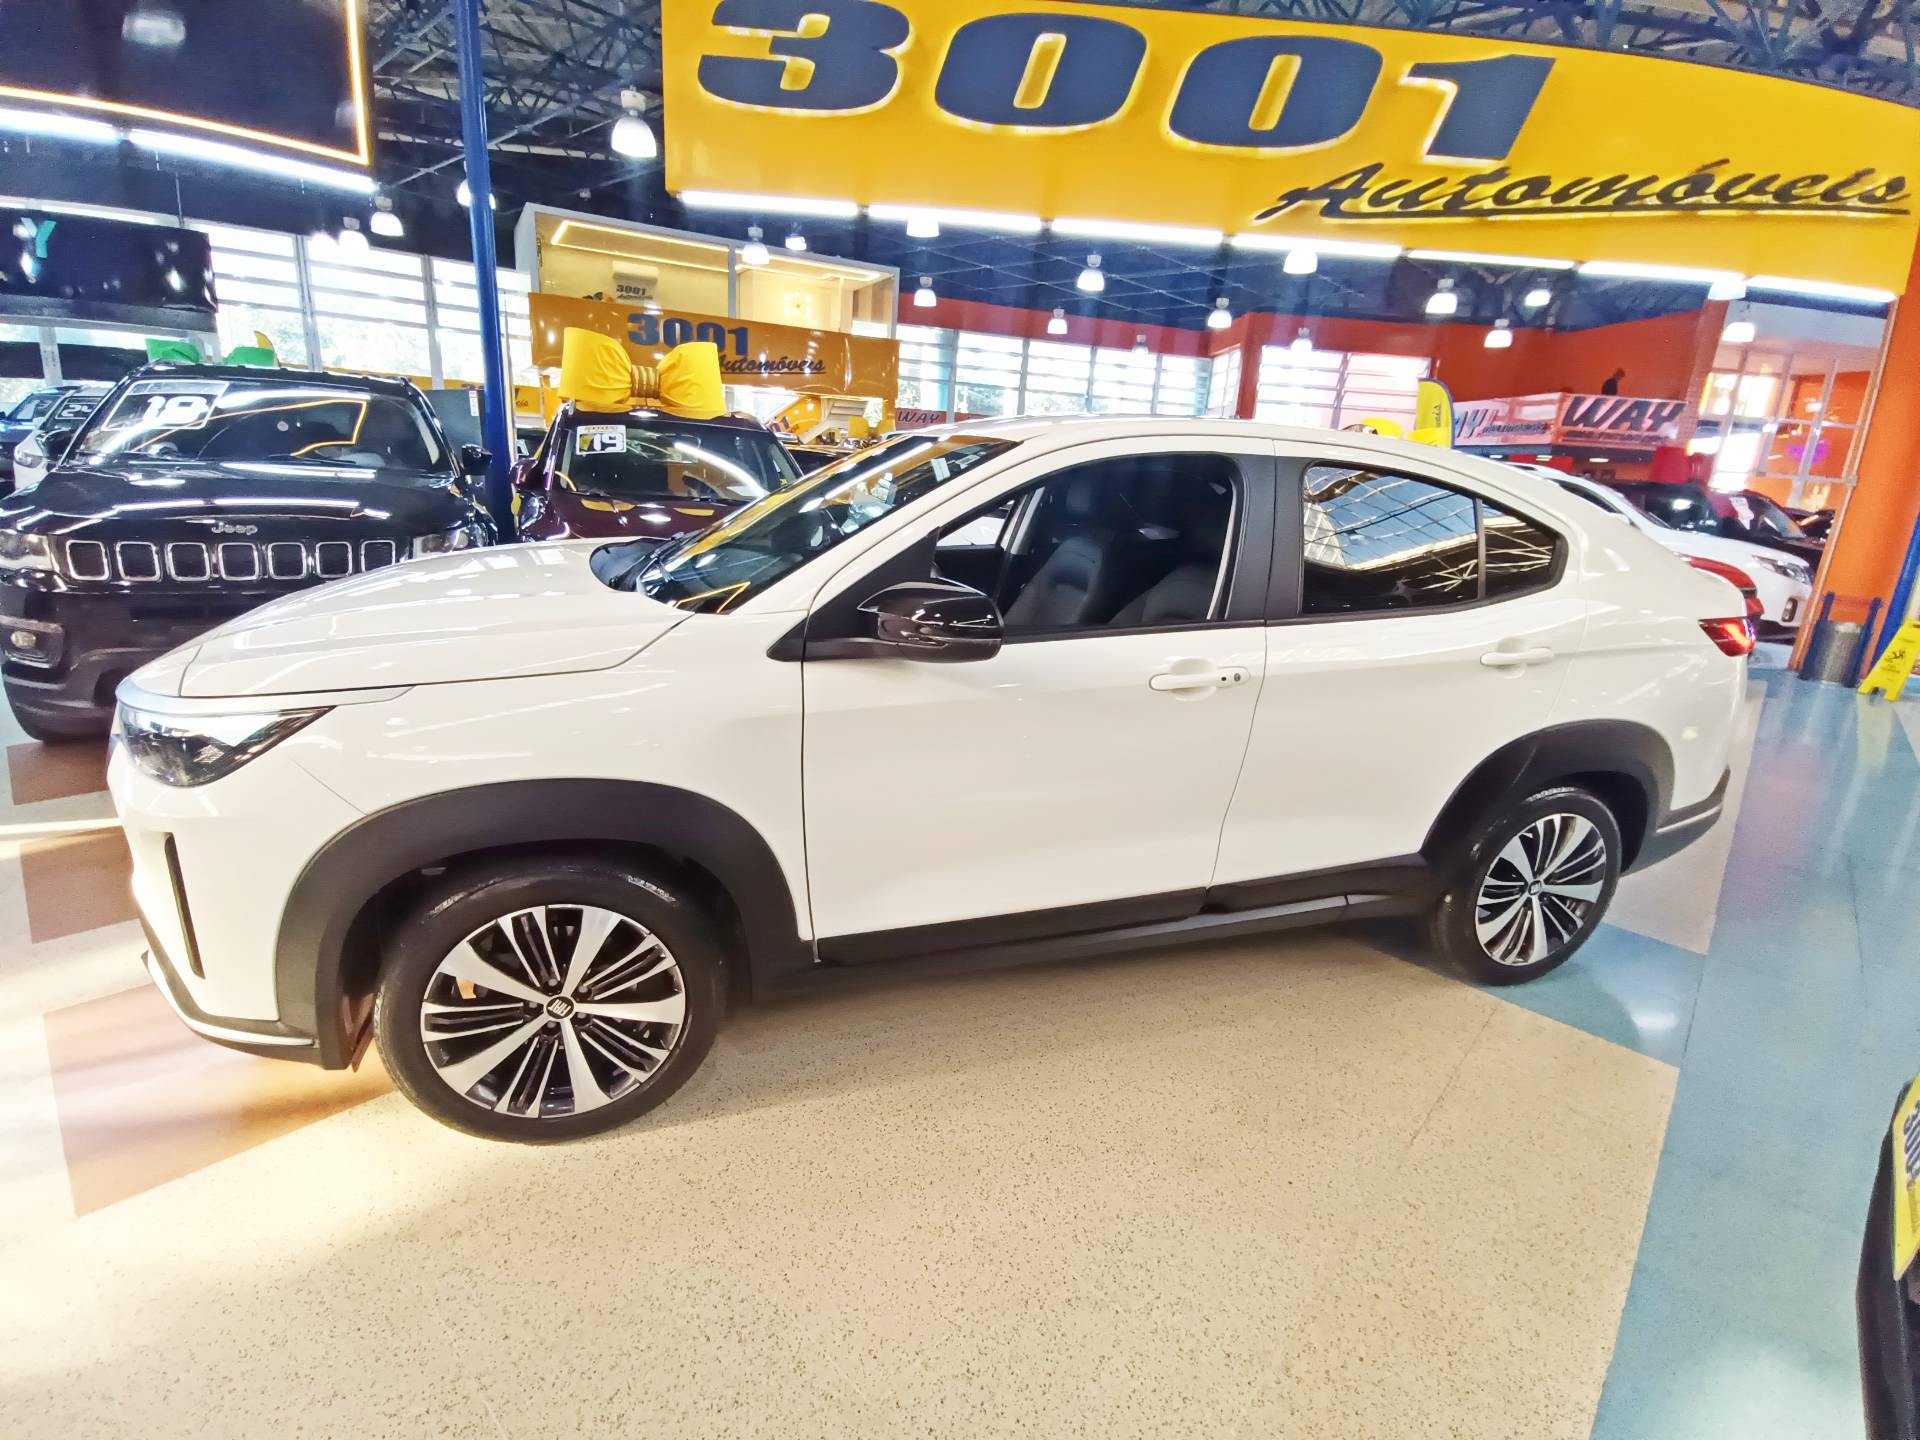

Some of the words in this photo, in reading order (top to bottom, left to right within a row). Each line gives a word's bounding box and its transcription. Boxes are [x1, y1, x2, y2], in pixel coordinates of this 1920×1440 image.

[697, 0, 1556, 162] 3001
[1254, 158, 1911, 221] Automóveis
[627, 312, 749, 356] 3001
[897, 411, 940, 424] WAY
[1561, 396, 1687, 432] WAY
[593, 433, 624, 452] 19
[211, 521, 258, 536] Jeep
